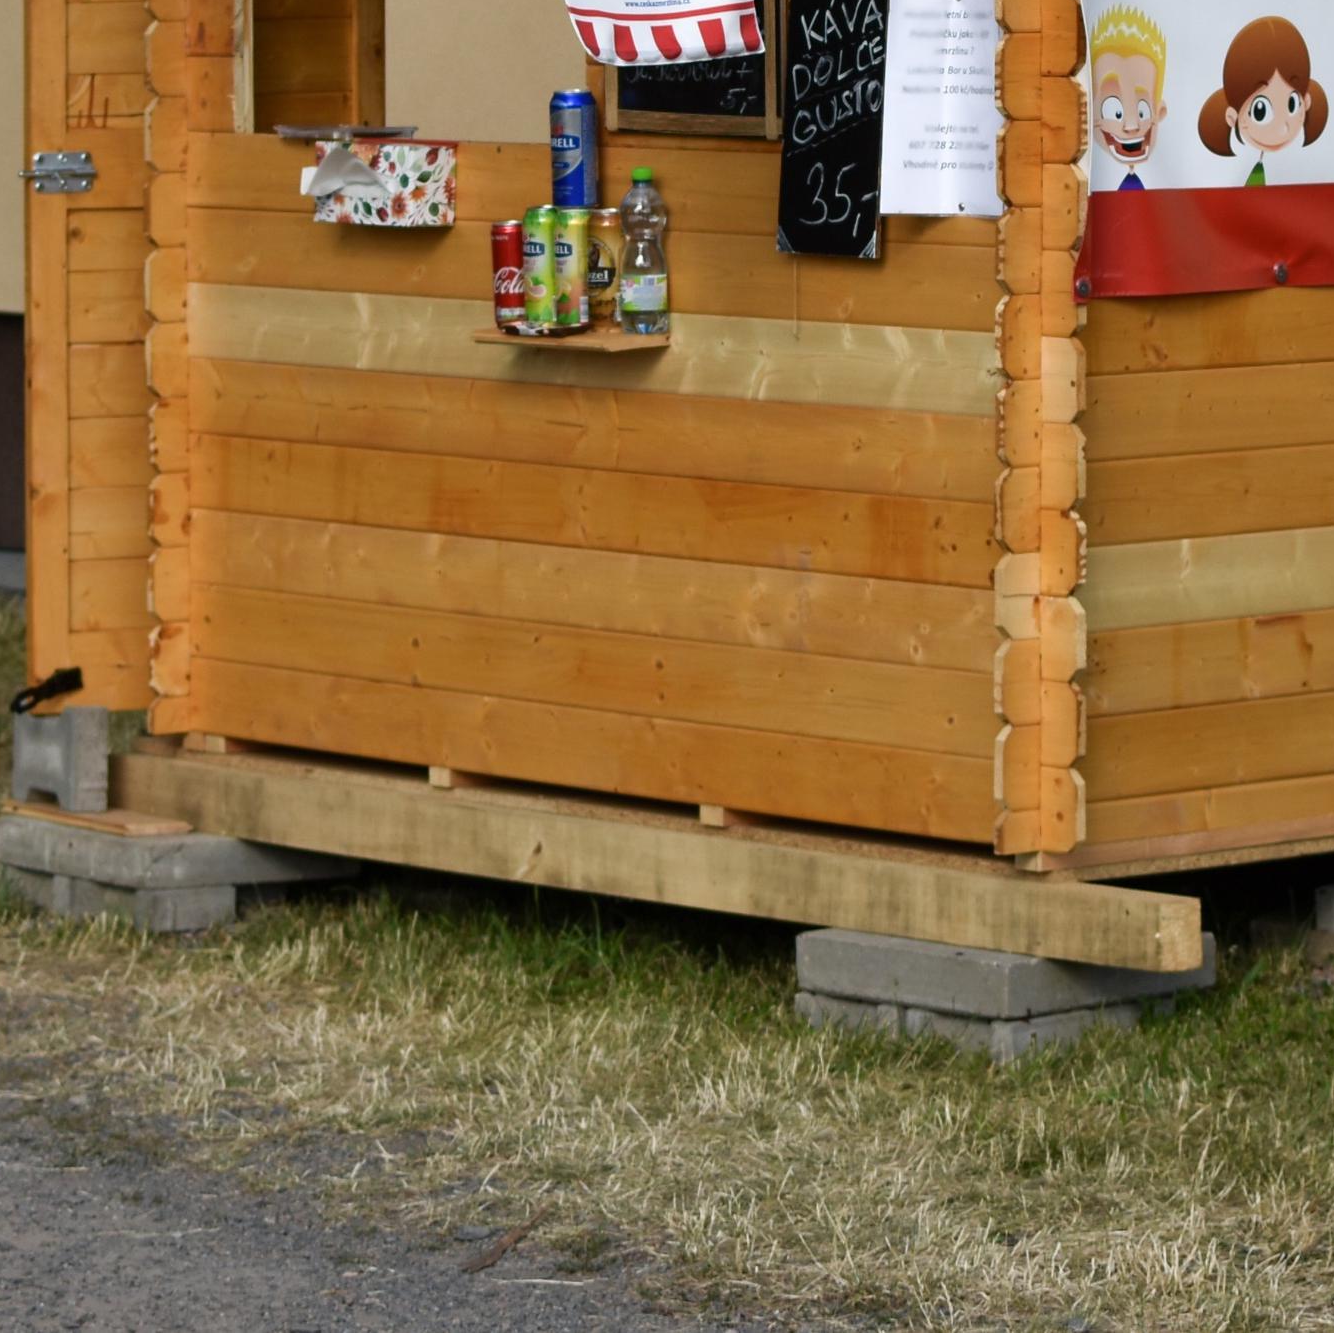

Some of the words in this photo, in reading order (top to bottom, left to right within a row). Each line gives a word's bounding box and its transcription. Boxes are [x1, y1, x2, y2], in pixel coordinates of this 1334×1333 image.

[792, 35, 886, 102] DOLCE
[792, 77, 884, 145] GUSTO
[798, 161, 879, 238] 35,-
[940, 161, 957, 171] pro
